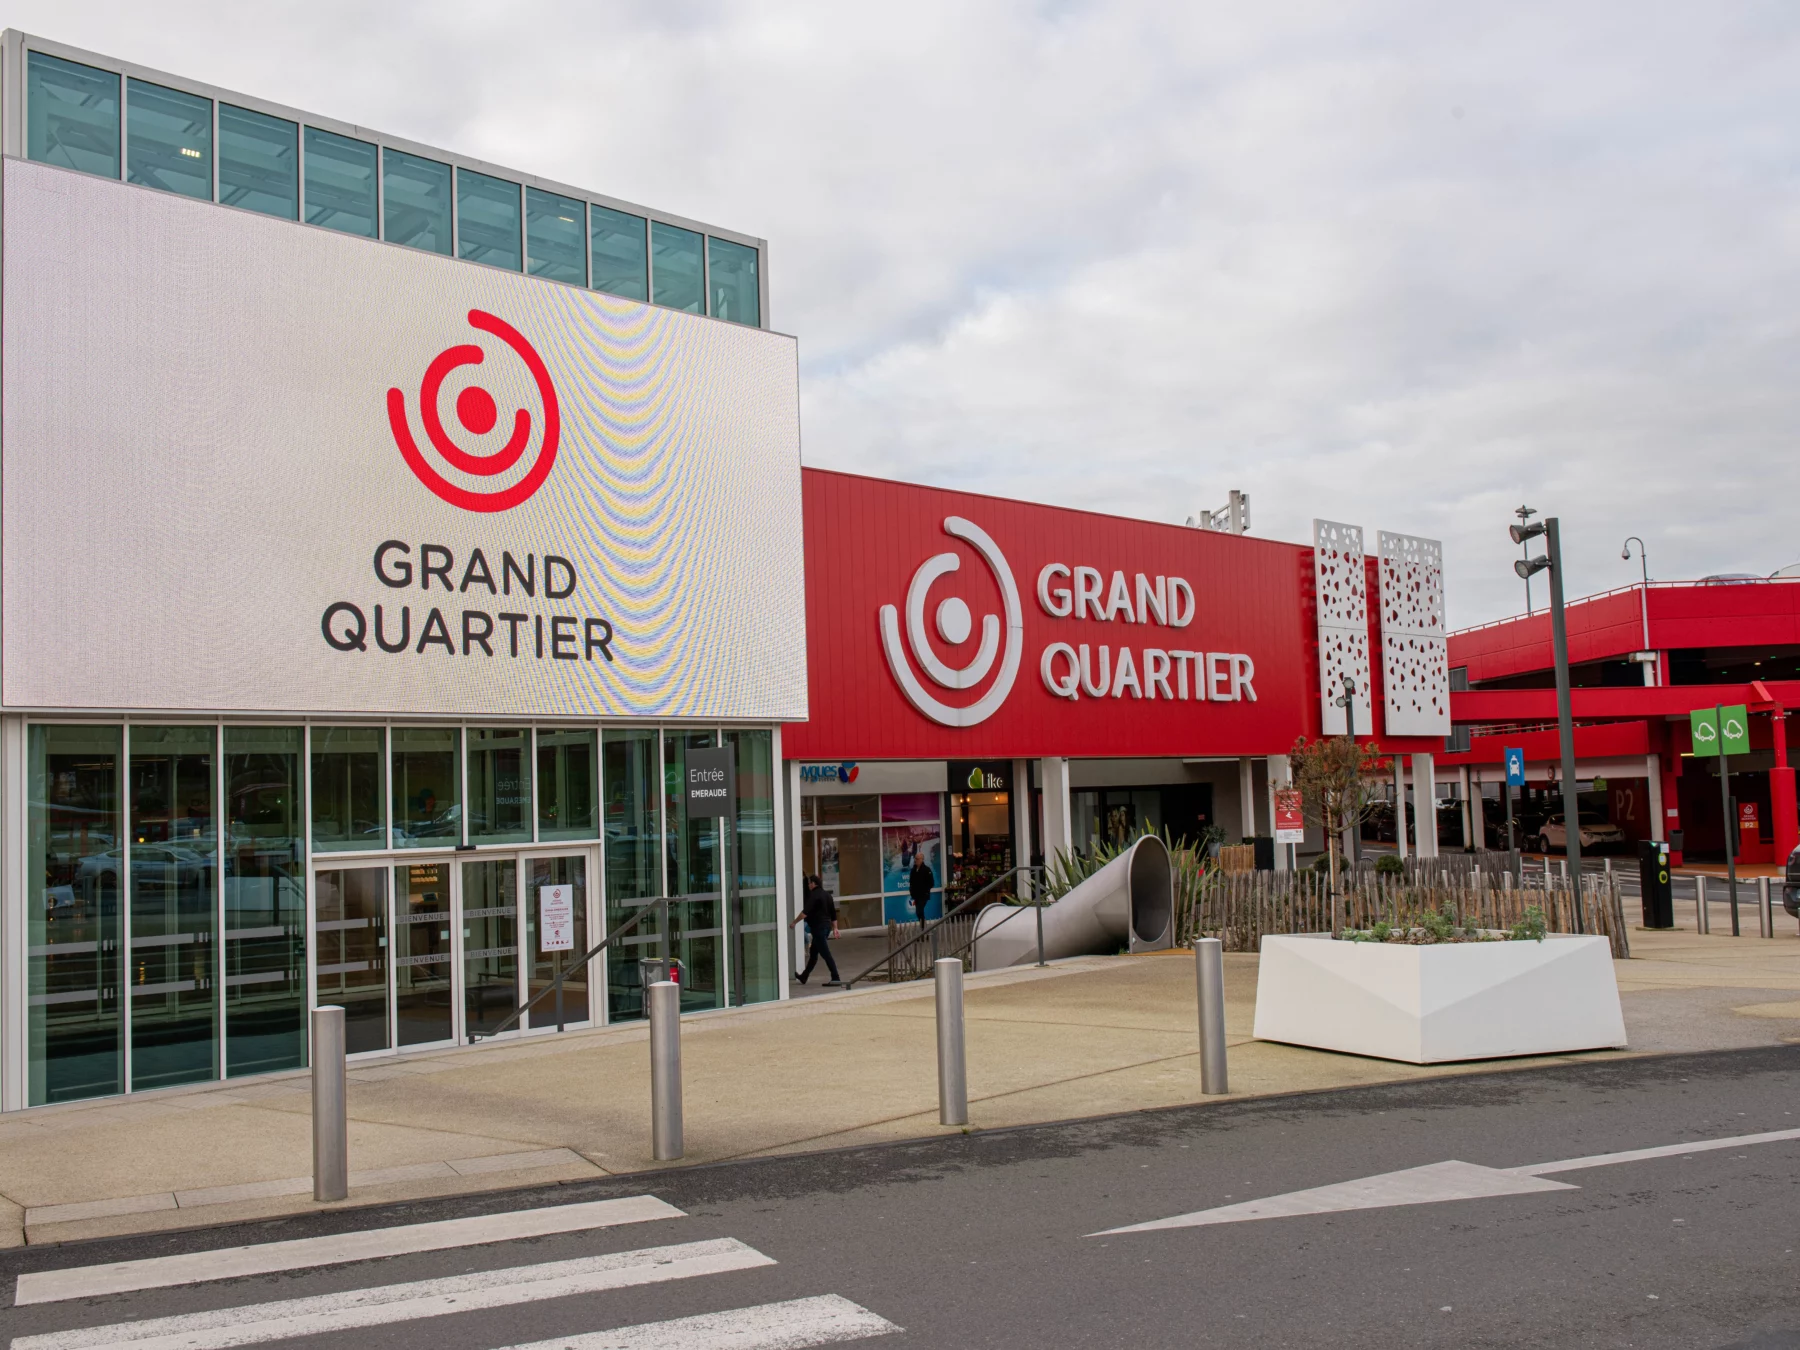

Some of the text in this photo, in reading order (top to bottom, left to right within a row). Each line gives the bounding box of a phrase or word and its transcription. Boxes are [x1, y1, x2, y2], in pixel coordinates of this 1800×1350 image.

[373, 539, 577, 599] GRAND
[1037, 563, 1195, 628] GRAND
[321, 601, 614, 662] QUARTIER
[1040, 642, 1257, 701] QUARTIER
[690, 767, 724, 783] Entrée
[981, 772, 1003, 789] Like
[691, 788, 727, 798] EMERAUDE
[1615, 788, 1635, 821] P2
[399, 913, 444, 923] BIENVENUE
[469, 907, 512, 917] BIENVENUE
[400, 955, 445, 965] BIENVENUE
[470, 948, 513, 958] BIENVENUE
